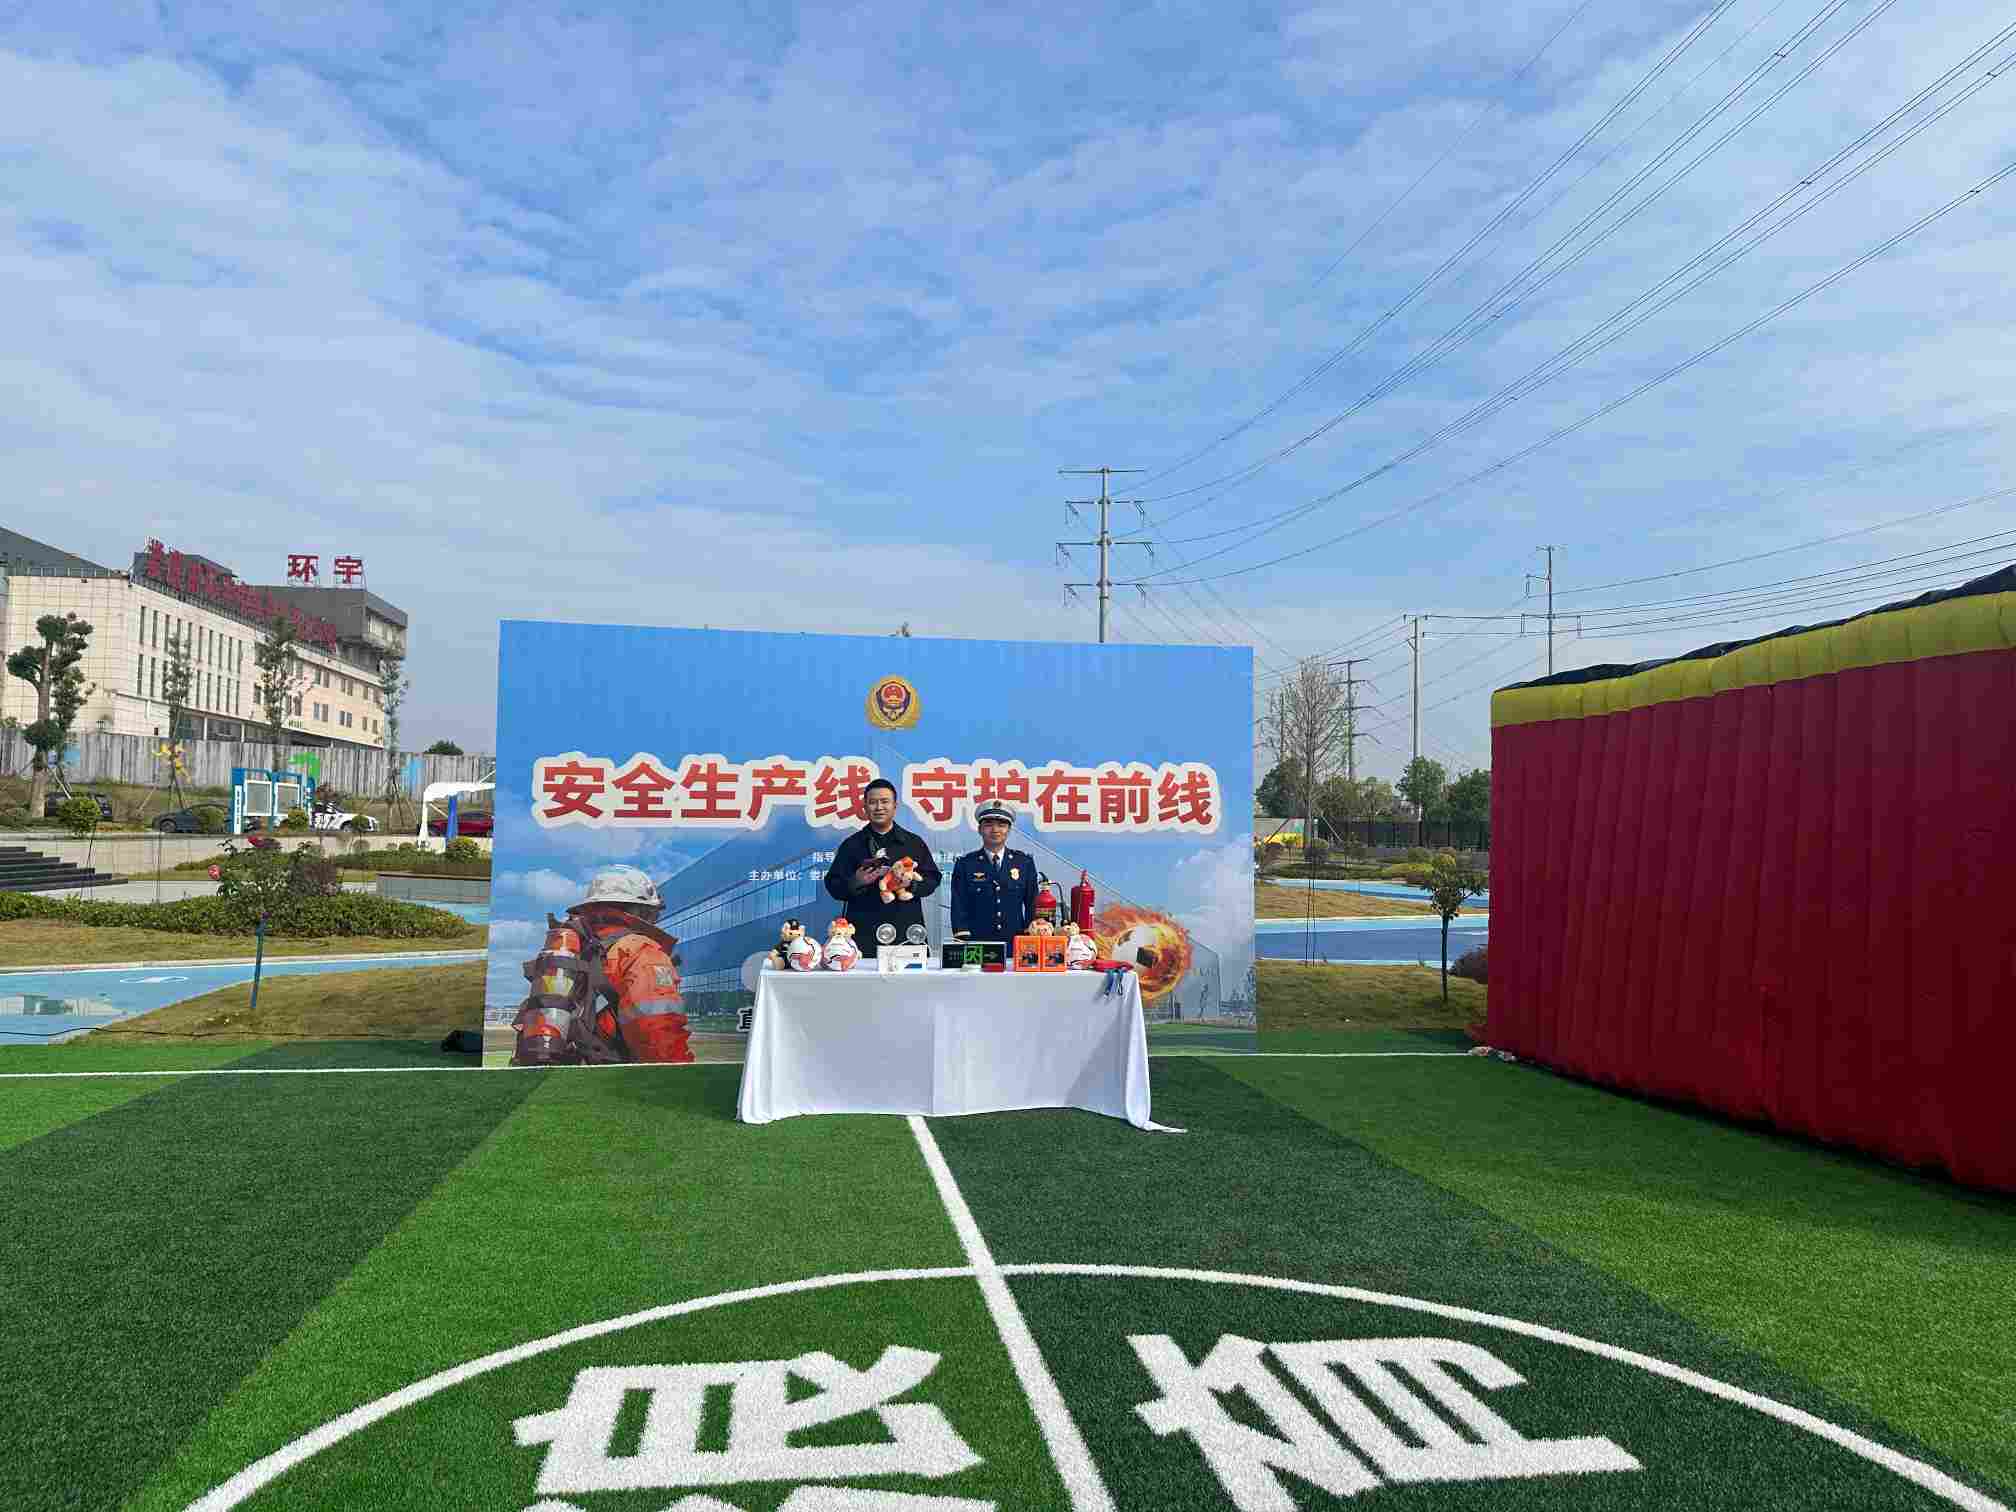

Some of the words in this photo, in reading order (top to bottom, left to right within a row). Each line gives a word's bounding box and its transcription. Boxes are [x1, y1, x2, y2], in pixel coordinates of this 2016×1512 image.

[288, 554, 363, 585] 环宇
[543, 761, 871, 821] 安全生产线
[911, 767, 1212, 825] 守护在前线
